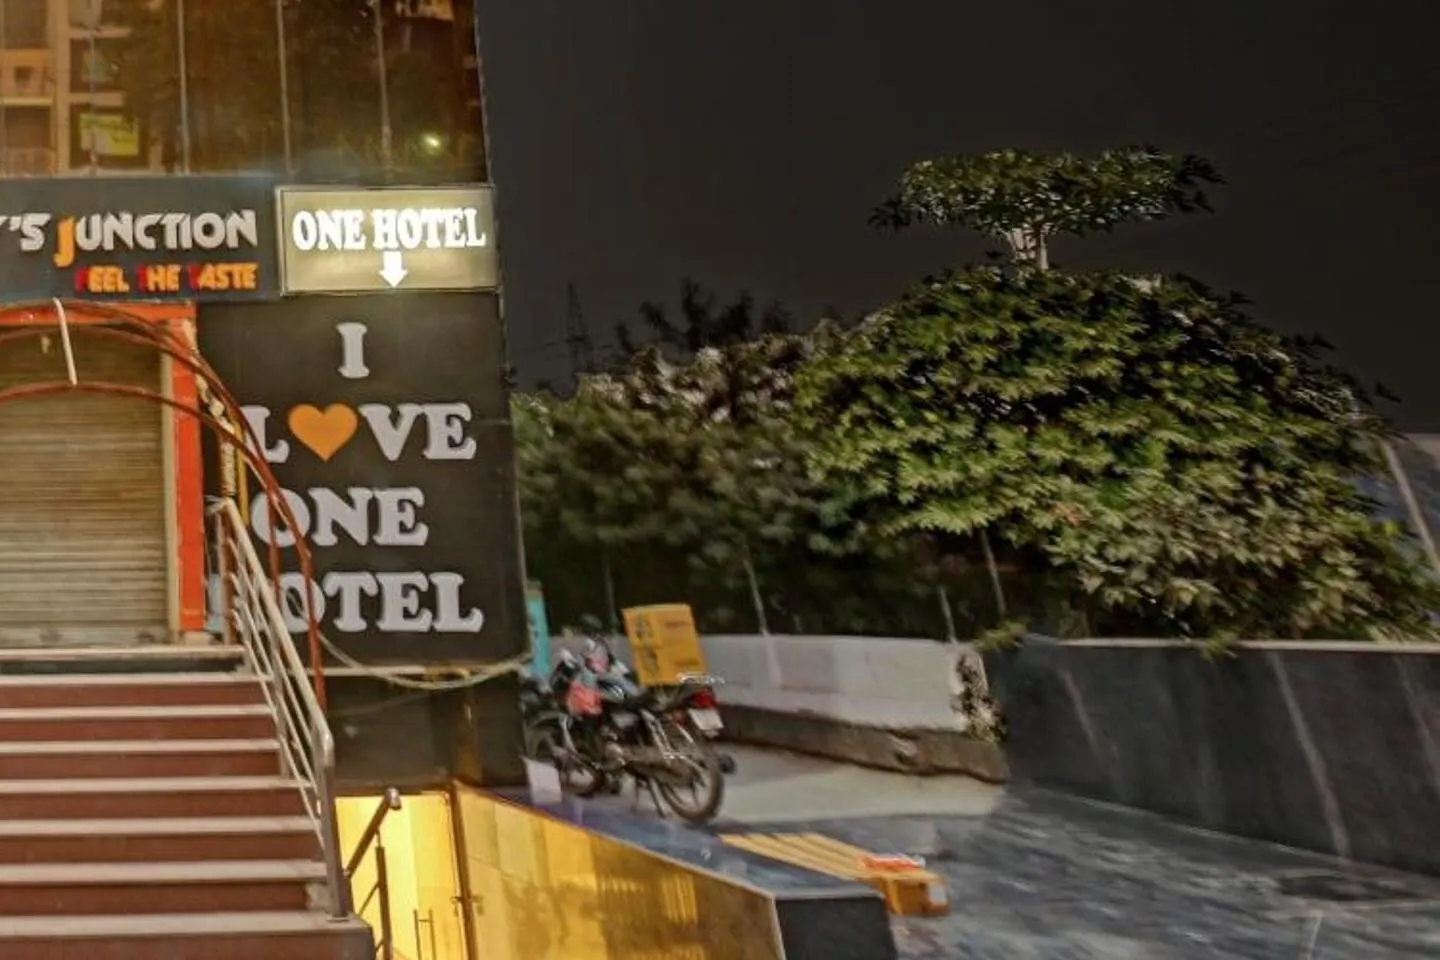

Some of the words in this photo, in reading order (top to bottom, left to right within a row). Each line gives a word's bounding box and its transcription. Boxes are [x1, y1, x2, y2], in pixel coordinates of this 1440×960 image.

[54, 209, 258, 268] JUNCTION
[291, 209, 366, 251] ONE
[368, 207, 487, 250] HOTEL
[136, 263, 181, 292] THE
[187, 261, 260, 291] TASTE
[336, 322, 370, 379] I
[251, 487, 429, 548] ONE
